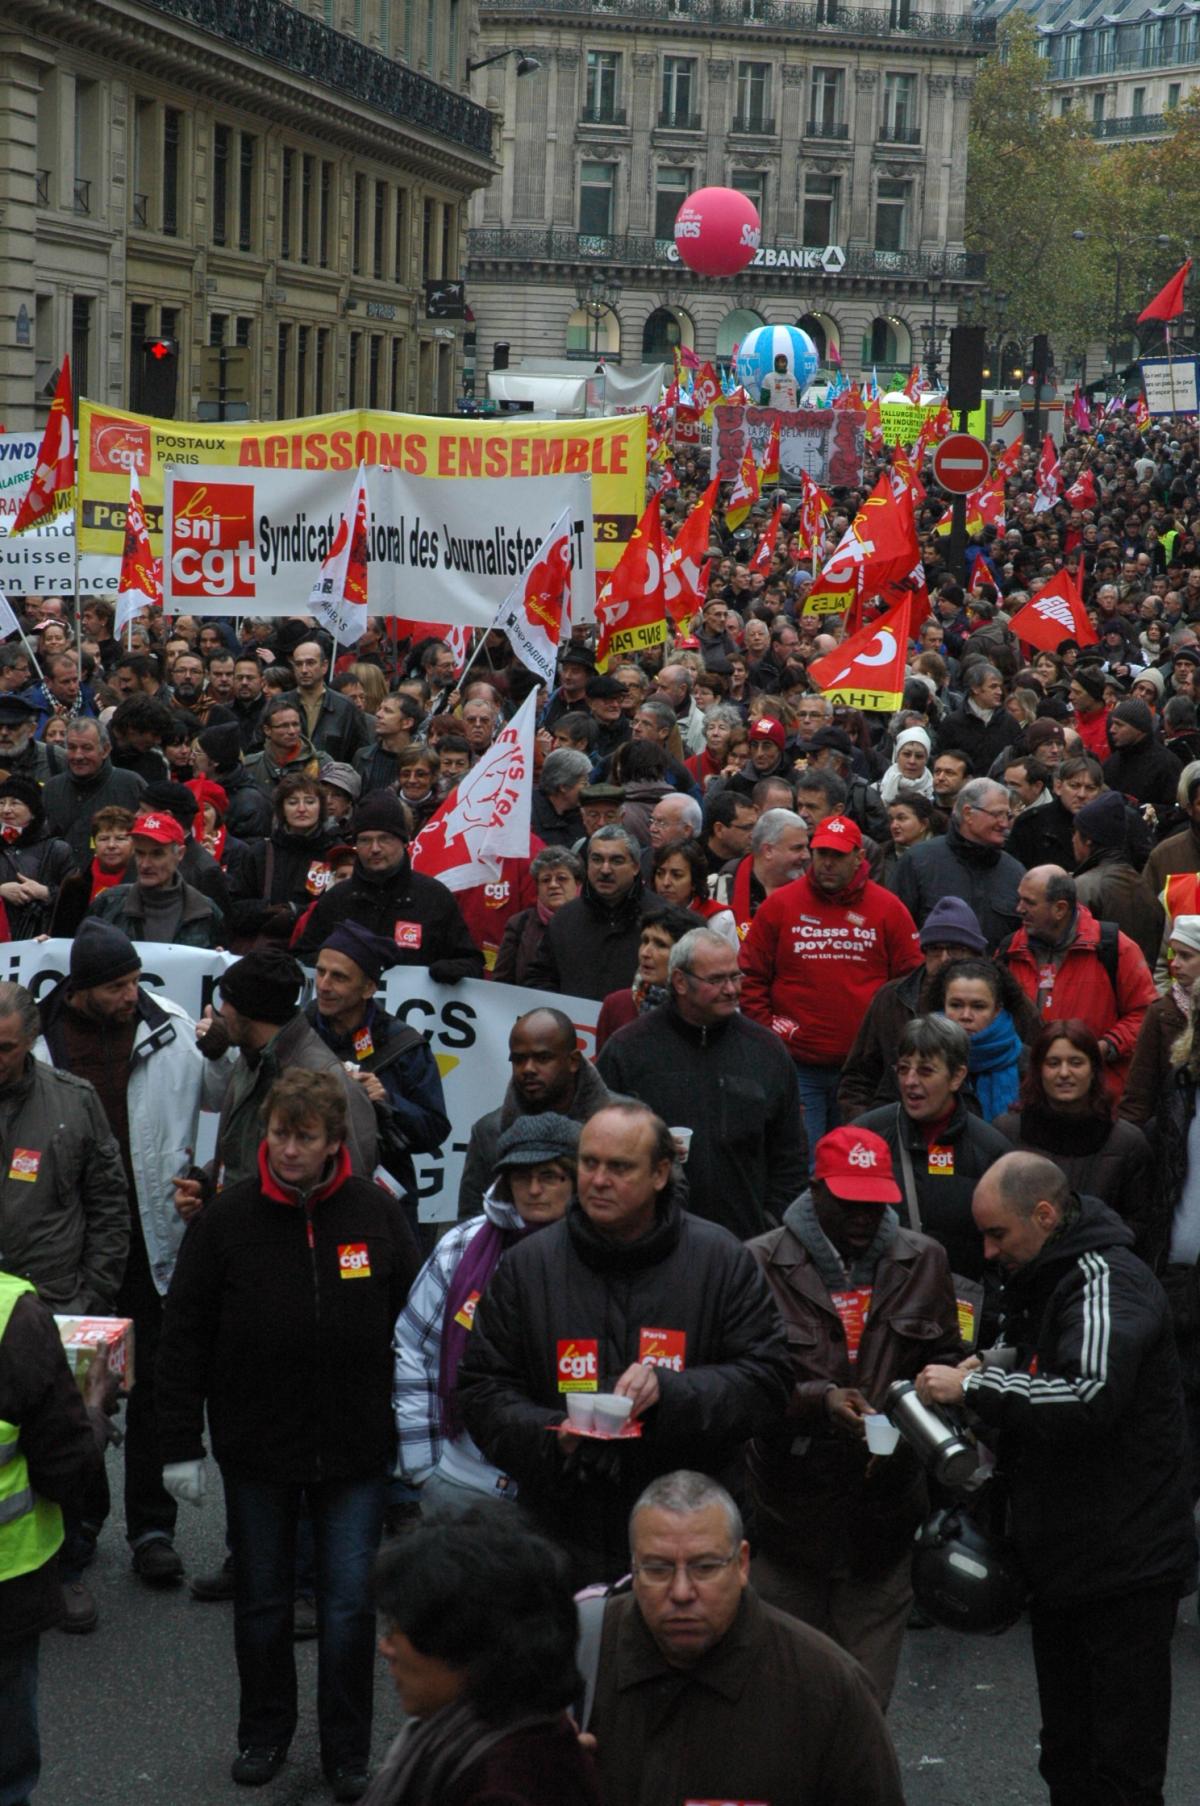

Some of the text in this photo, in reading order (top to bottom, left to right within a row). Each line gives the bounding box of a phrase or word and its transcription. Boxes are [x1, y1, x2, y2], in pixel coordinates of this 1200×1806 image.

[156, 435, 226, 450] POSTAUX
[108, 448, 145, 471] cgt
[157, 451, 200, 465] PARIS
[239, 431, 629, 478] AGISSONS ENSEMBLE
[174, 514, 221, 546] snj
[259, 512, 335, 576] Syndicat
[409, 517, 439, 569] des
[172, 540, 257, 595] cgt
[484, 881, 510, 900] cgt
[853, 926, 876, 941] toi
[848, 1148, 877, 1168] cgt
[928, 1150, 953, 1168] cgt
[340, 1251, 369, 1270] cgt
[559, 1352, 597, 1379] cgt
